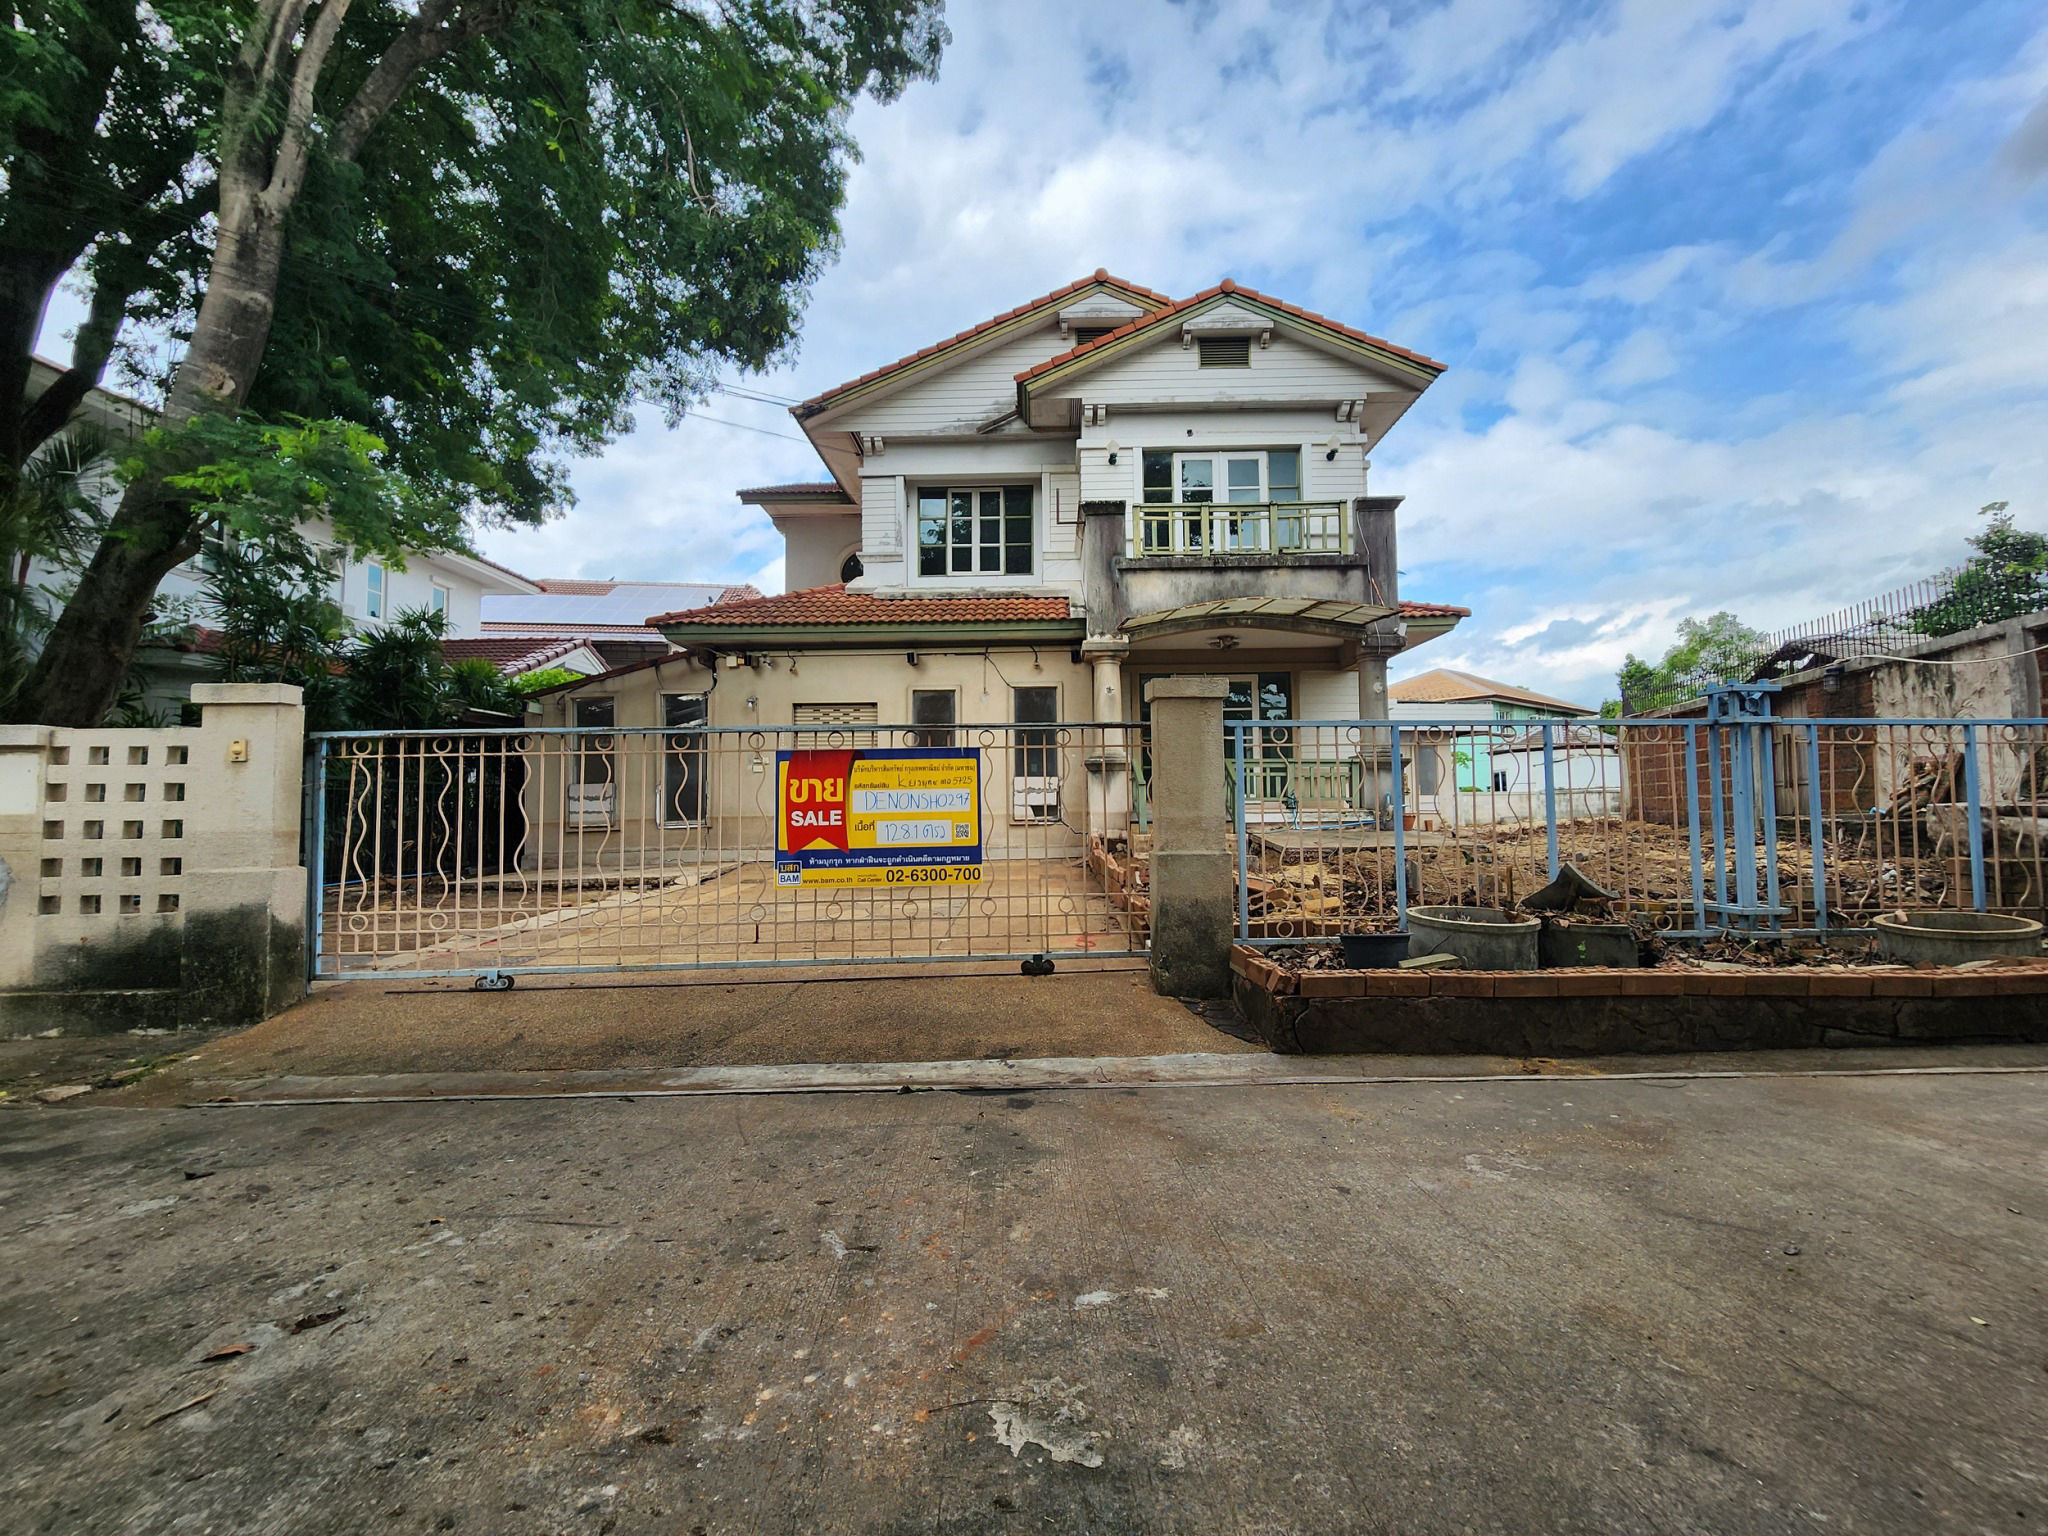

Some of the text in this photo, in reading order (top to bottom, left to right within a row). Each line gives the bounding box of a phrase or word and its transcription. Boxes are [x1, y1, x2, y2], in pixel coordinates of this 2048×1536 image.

[790, 778, 844, 803] ขาย
[791, 810, 843, 827] SALE
[854, 819, 876, 832] เนื้อที่
[809, 856, 843, 867] ห้ามบุกรุก
[780, 874, 800, 883] BAM
[886, 868, 981, 883] 02-6300-700
